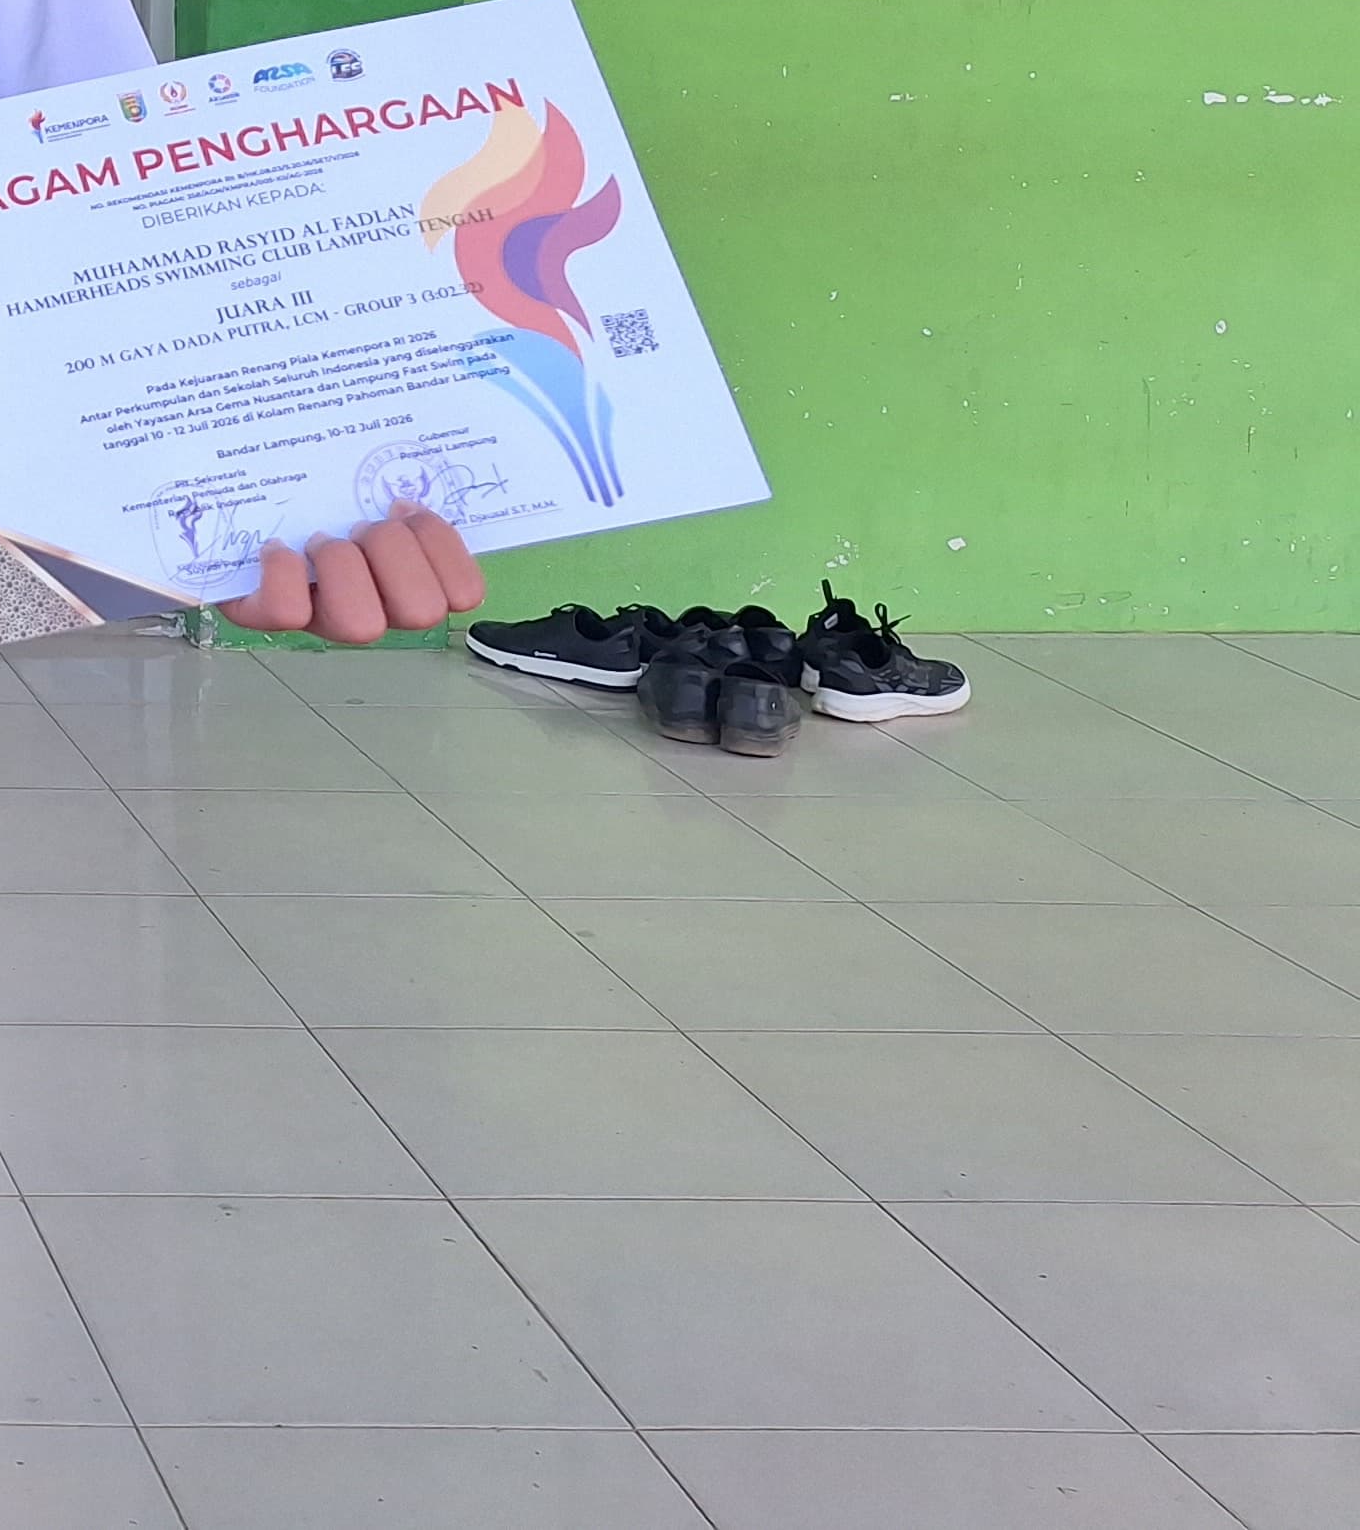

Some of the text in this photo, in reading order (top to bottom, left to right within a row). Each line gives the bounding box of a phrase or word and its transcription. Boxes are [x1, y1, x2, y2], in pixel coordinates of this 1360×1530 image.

[44, 114, 108, 133] KEMENPORA
[131, 77, 526, 181] PENGHARGAAN
[73, 201, 417, 284] MUHAMMAD RASYID AL FADLAN
[141, 197, 241, 228] DIBERIKAN
[245, 182, 325, 206] KEPADA:
[6, 206, 495, 316] HAMMERHEADS SWIMMING CLUB LAMPUNG TENGAH
[230, 271, 281, 290] sebagai
[64, 358, 94, 373] 200
[100, 353, 114, 365] M
[119, 342, 168, 361] GAYA
[172, 331, 222, 350] DADA
[227, 319, 289, 339] PUTRA,
[293, 310, 328, 326] LCM
[344, 295, 402, 315] GROUP
[406, 293, 416, 304] 3
[216, 290, 312, 323] JUARA III
[80, 329, 515, 423] Antar Perkumpulan dan Sekolah Seluruh Indonesia yang diselenggarakan
[106, 422, 132, 433] oleh
[134, 412, 183, 427] Yayasan
[187, 406, 212, 417] Arsa
[252, 387, 314, 403] Nusantara
[317, 382, 339, 391] dan
[342, 370, 399, 387] Lampung
[402, 364, 428, 375] Fast
[429, 354, 466, 373] Swim
[465, 348, 498, 366] pada
[146, 330, 436, 393] Pada Kejuaraan Renang Piala Kemenpora RI 2026
[103, 361, 511, 449] tanggal 10 12 Juli 2026 di Kolam Renang Pahoman Bandar Lampung
[216, 413, 413, 458] Bandar Lampung, 10-12 Juli 2026
